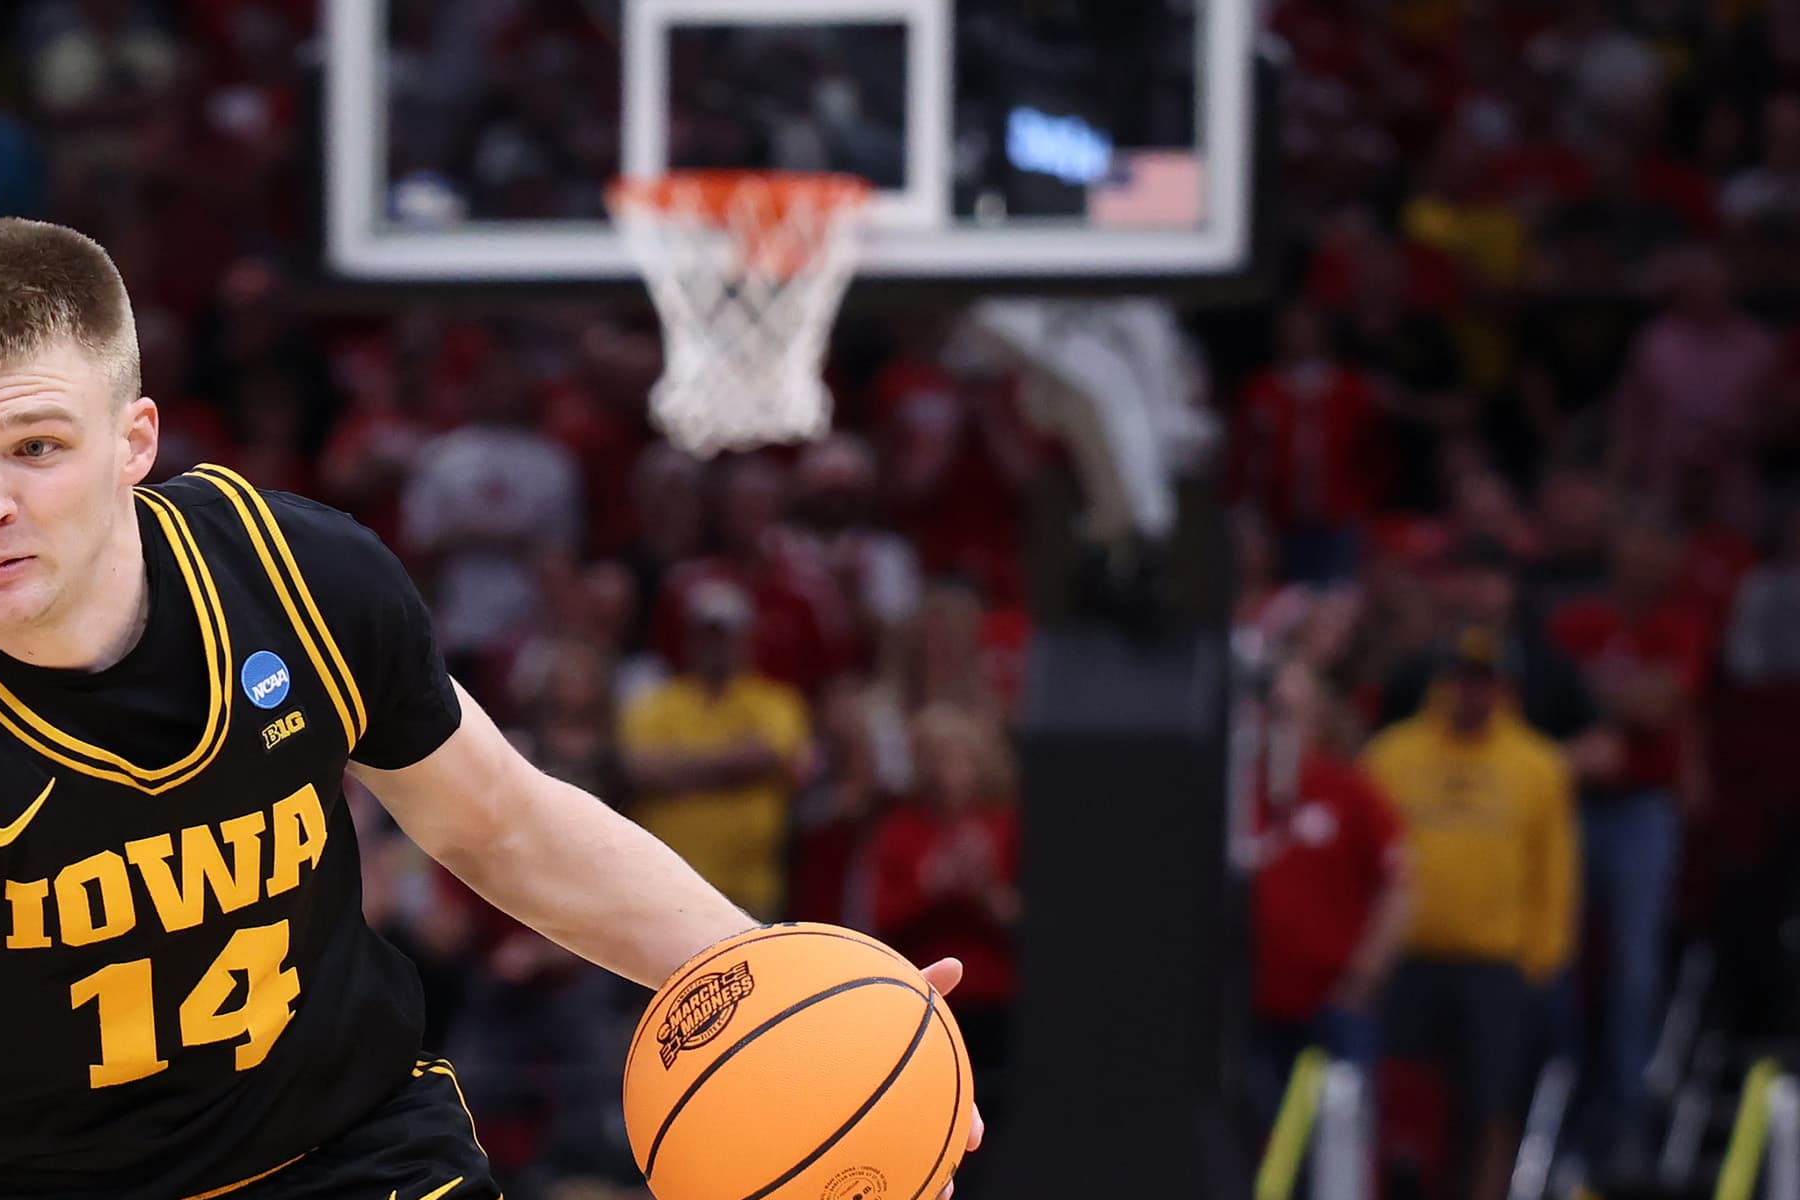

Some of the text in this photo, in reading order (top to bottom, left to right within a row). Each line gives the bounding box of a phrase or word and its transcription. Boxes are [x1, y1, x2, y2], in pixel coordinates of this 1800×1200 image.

[251, 668, 289, 701] NCAA
[5, 783, 328, 949] IOWA
[70, 919, 301, 1090] 14
[669, 979, 720, 1027] MARCH
[680, 975, 754, 1036] MADNESS
